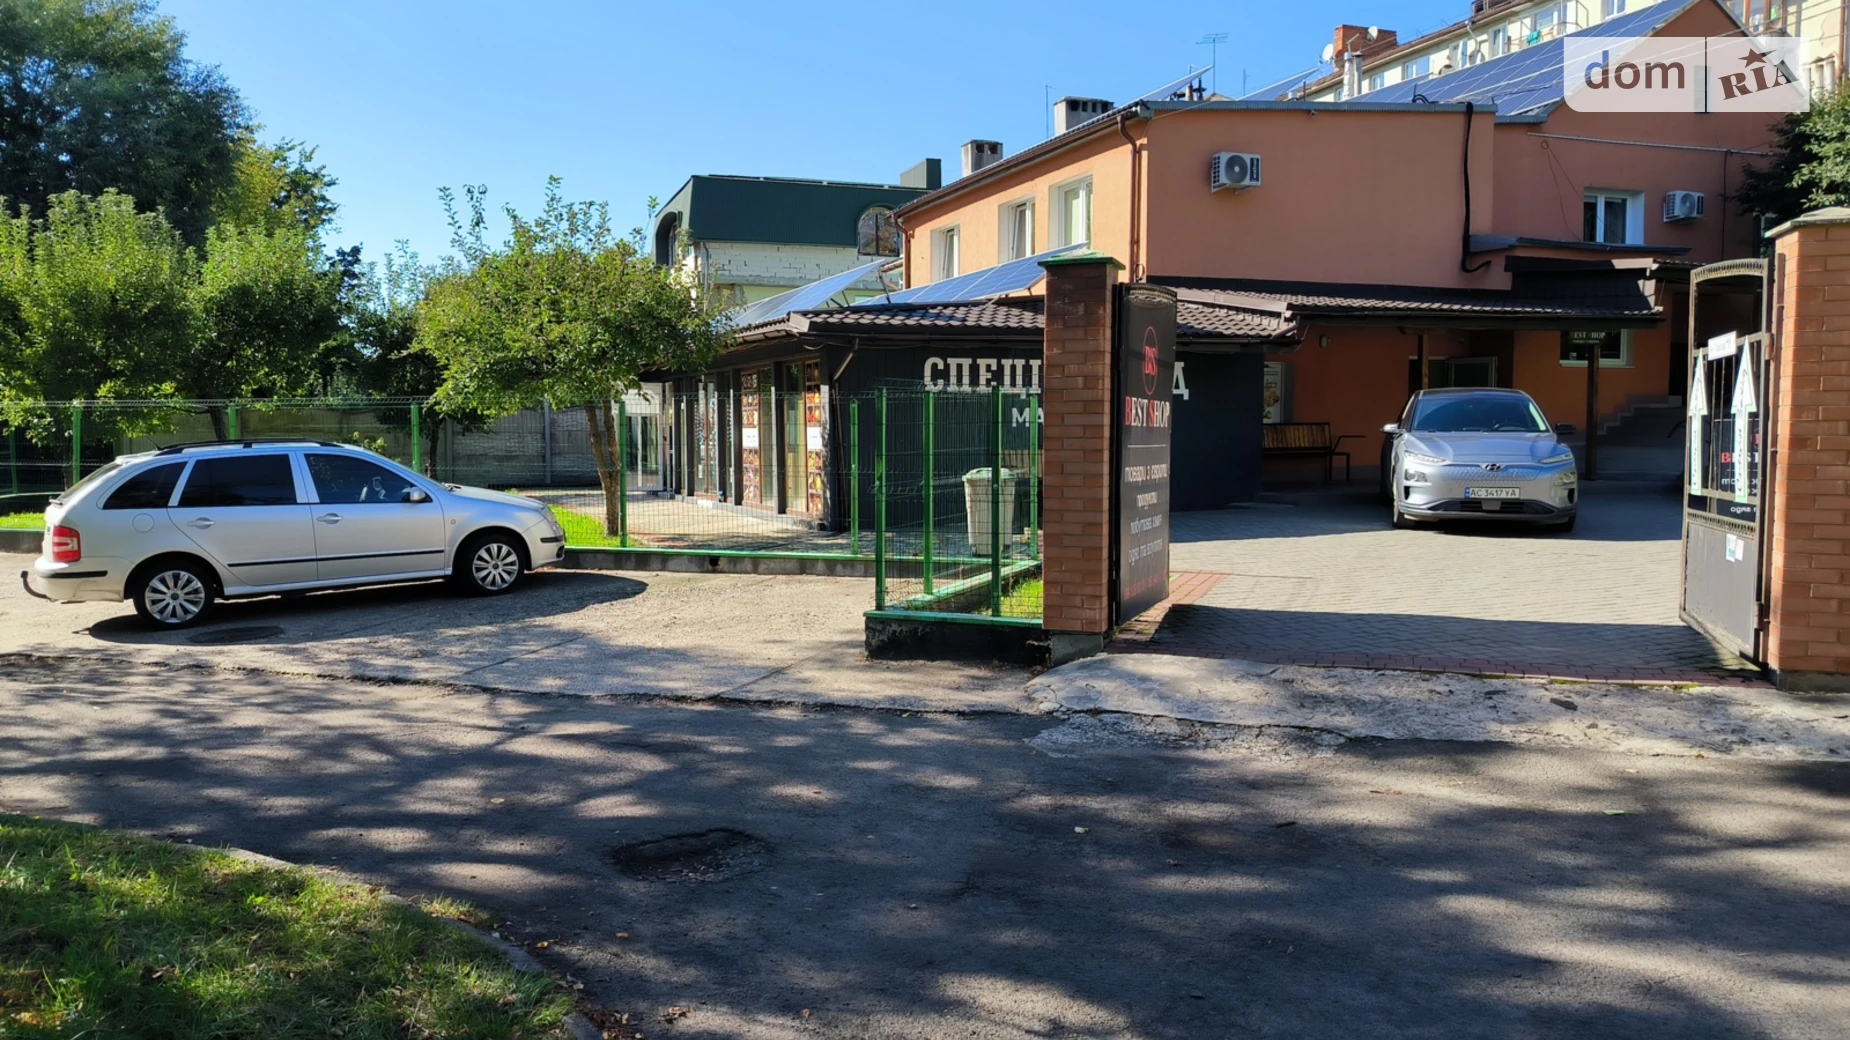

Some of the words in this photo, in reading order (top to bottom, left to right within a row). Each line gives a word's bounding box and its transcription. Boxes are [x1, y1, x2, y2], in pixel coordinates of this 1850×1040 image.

[1145, 345, 1156, 376] BS
[1125, 396, 1148, 426] BEST
[1149, 399, 1171, 428] SHOP
[1470, 488, 1482, 497] AC
[1484, 488, 1503, 497] 3417
[1505, 488, 1517, 497] YA
